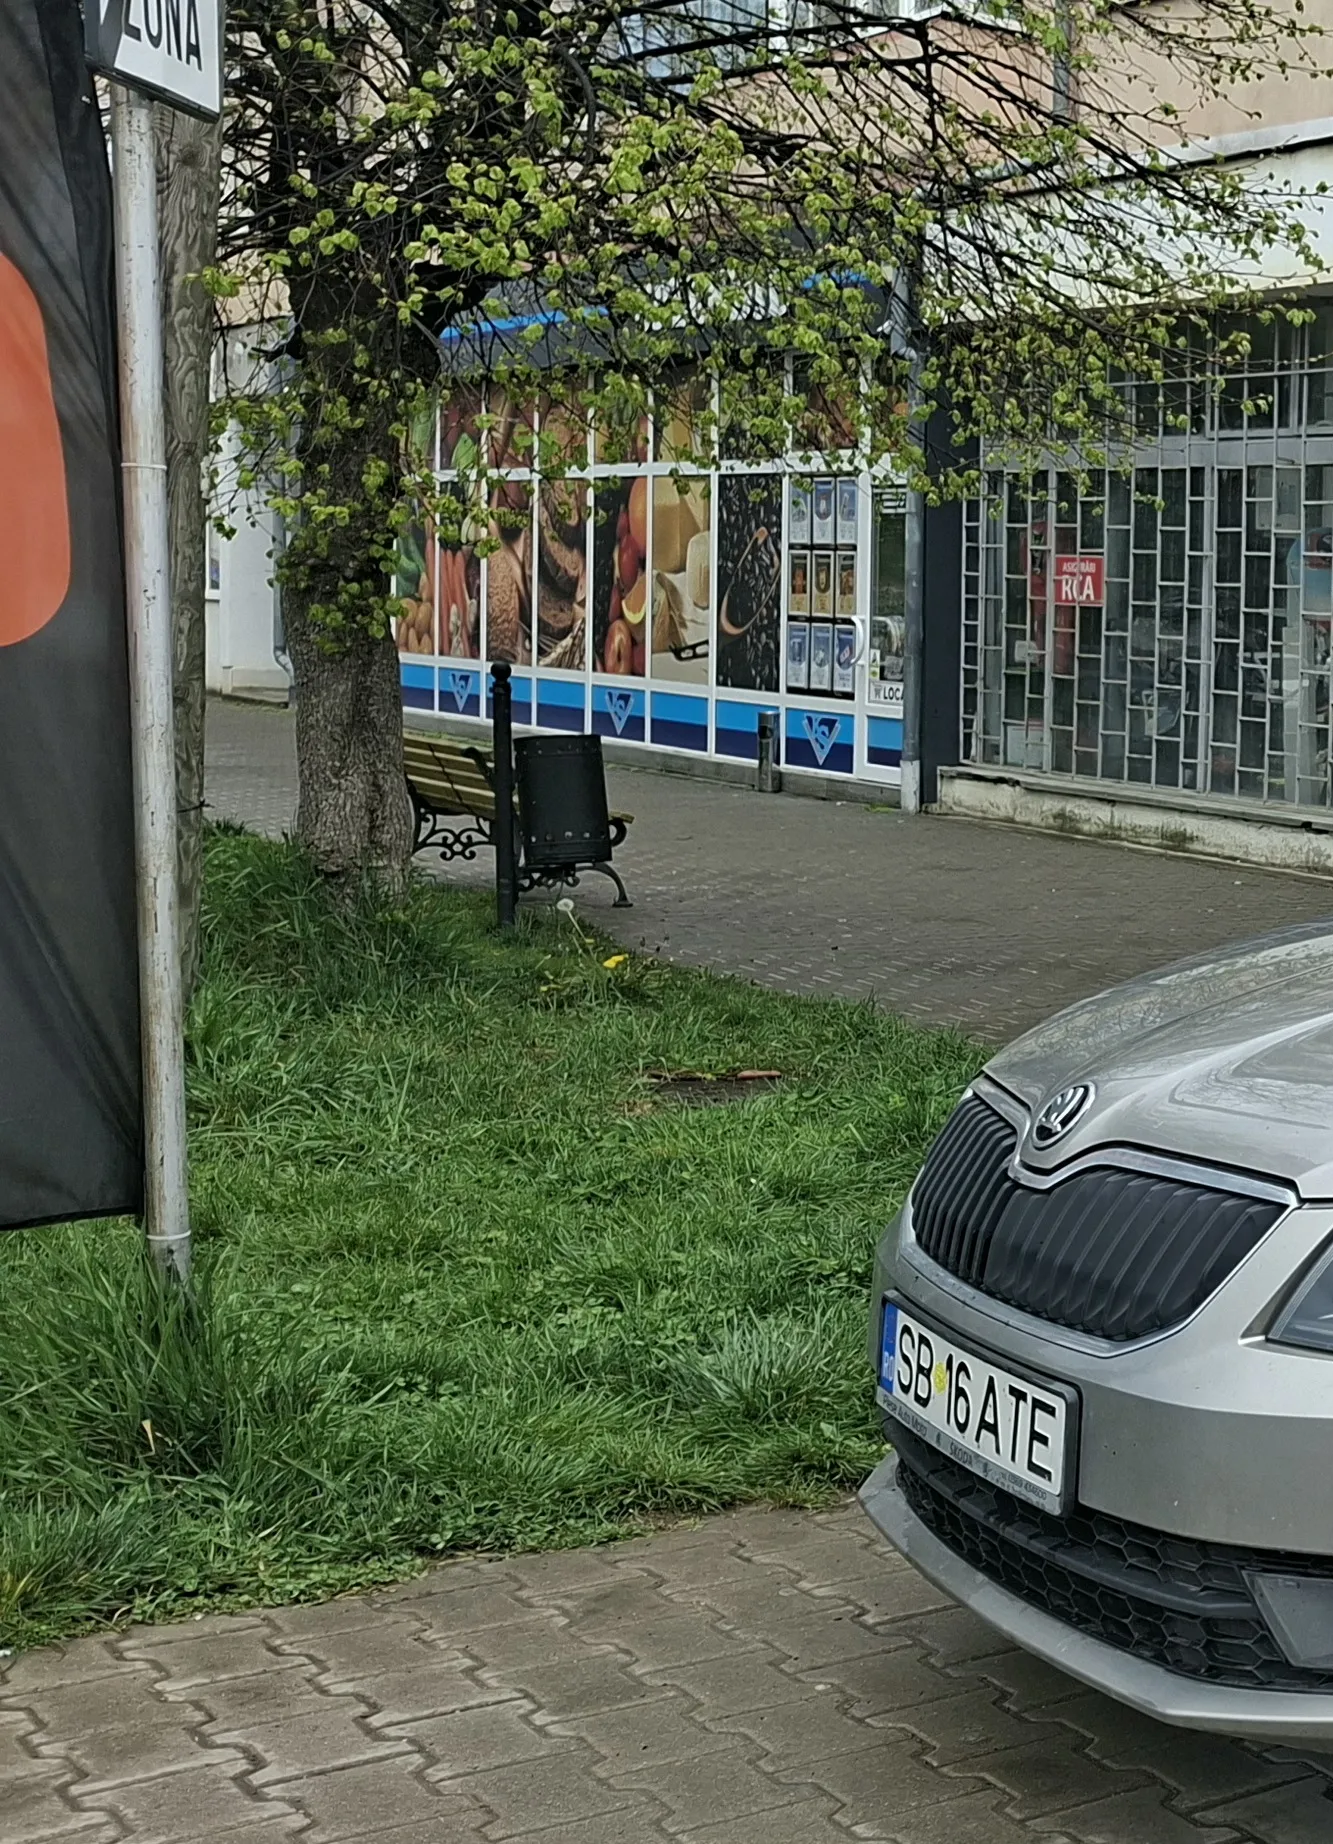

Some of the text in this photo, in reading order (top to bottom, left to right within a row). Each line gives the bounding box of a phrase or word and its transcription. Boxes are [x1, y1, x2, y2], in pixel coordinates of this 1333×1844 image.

[1062, 575, 1094, 601] RCA
[897, 1323, 935, 1409] SB
[974, 1374, 1057, 1483] ATE
